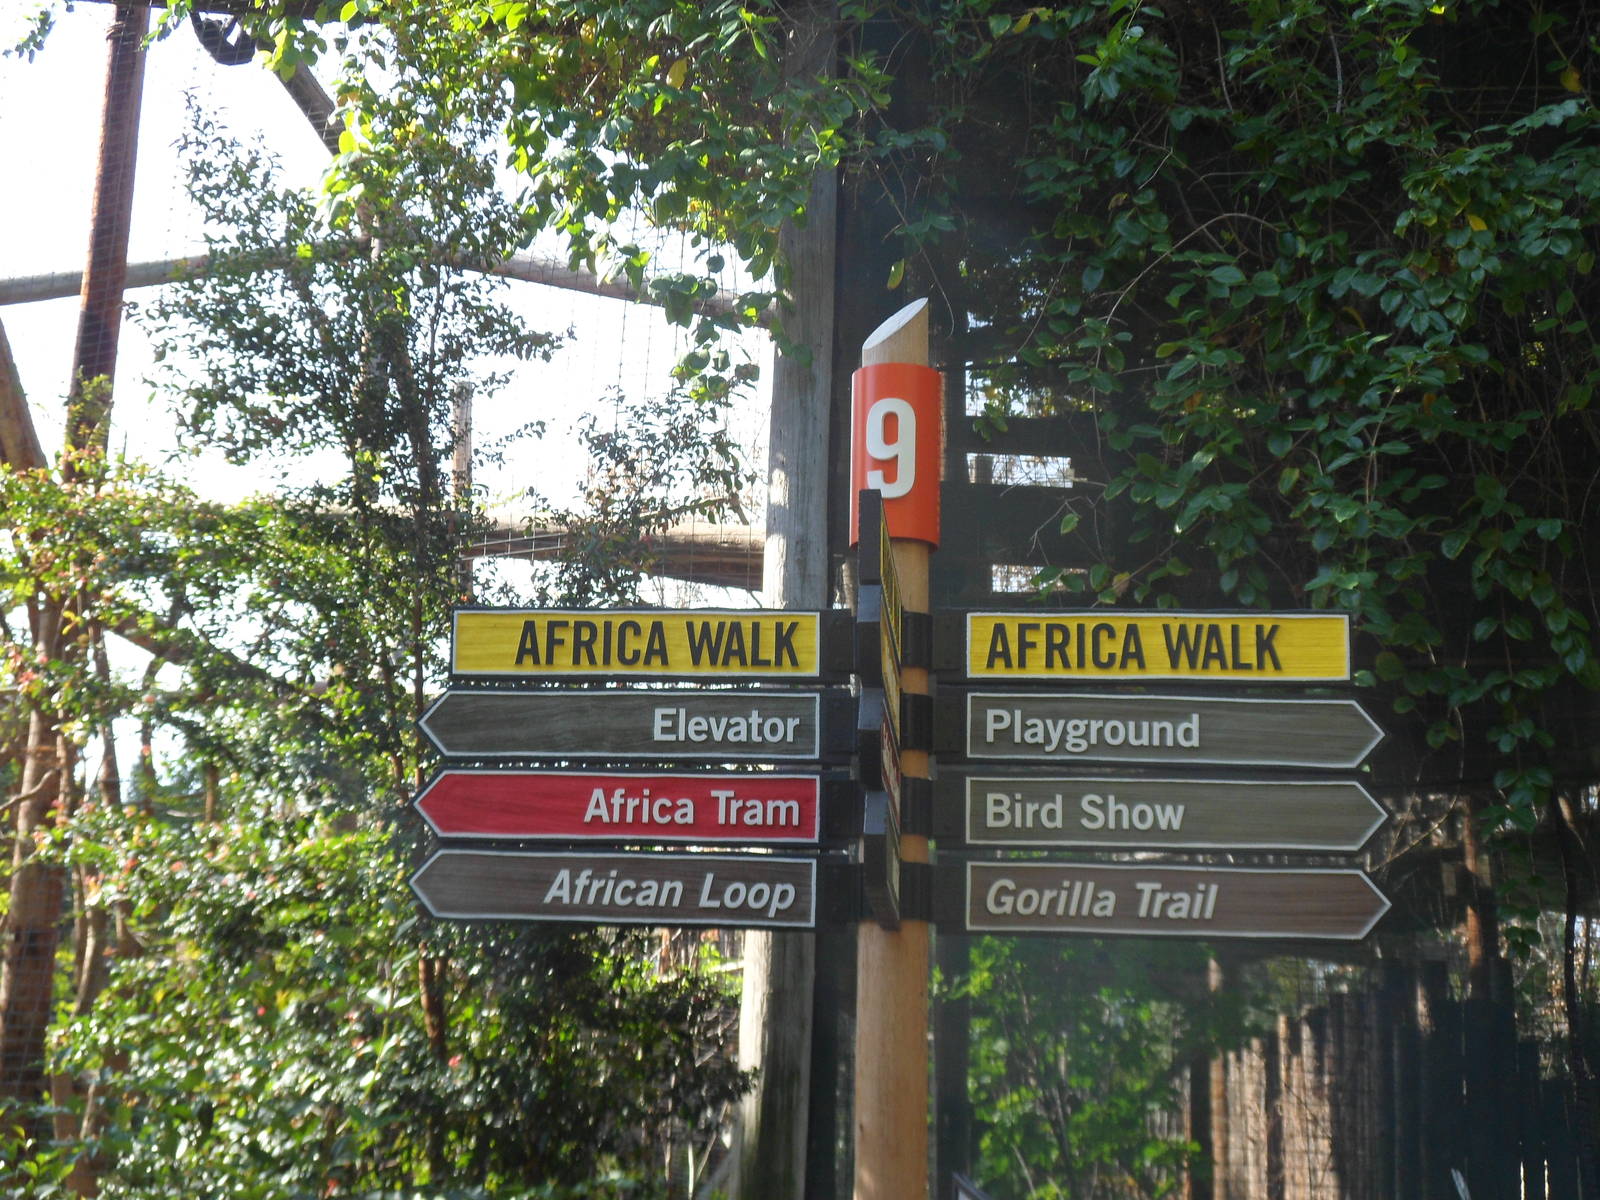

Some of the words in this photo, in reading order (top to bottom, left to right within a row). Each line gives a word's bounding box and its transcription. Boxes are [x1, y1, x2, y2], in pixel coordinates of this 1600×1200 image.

[866, 398, 916, 498] 9
[515, 620, 669, 666] AFRICA
[686, 621, 800, 667] WALK
[985, 622, 1146, 669] AFRICA
[1162, 624, 1283, 671] WALK
[653, 708, 800, 742] Elevator
[985, 709, 1200, 752] Playground
[583, 788, 695, 824] Africa
[710, 790, 800, 826] Tram
[985, 792, 1063, 828] Bird
[1080, 794, 1185, 830] Show
[543, 868, 684, 907] African
[698, 872, 796, 917] Loop
[985, 879, 1117, 917] Gorilla
[1135, 882, 1219, 919] Trail
